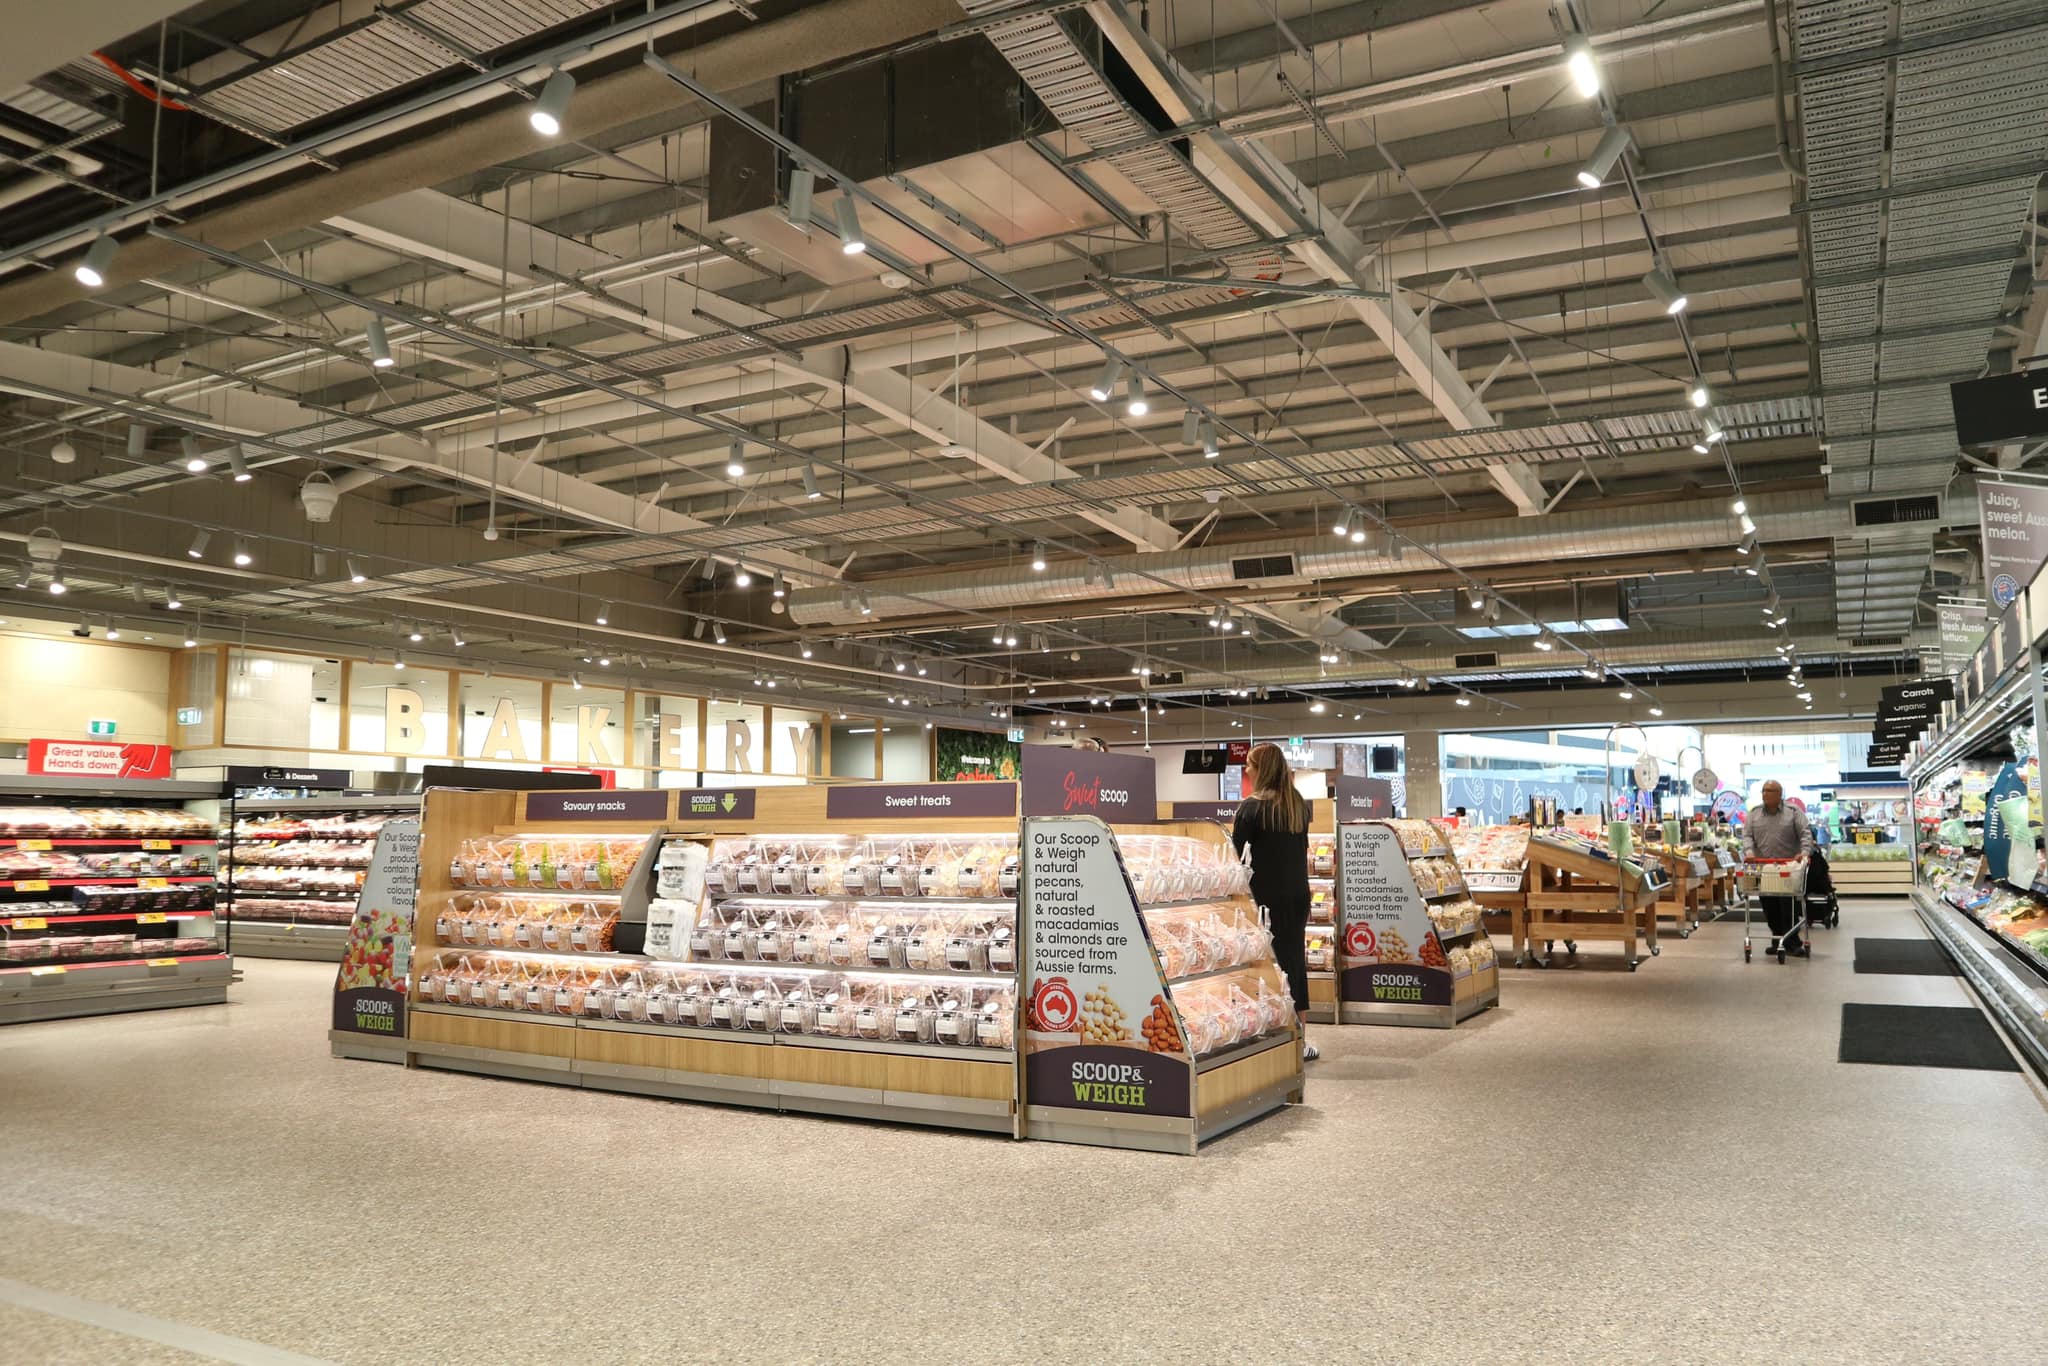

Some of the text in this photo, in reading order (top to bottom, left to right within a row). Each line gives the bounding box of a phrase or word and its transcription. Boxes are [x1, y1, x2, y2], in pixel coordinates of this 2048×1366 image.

[1987, 511, 2023, 524] sweet
[1988, 526, 2030, 541] melon.
[1901, 687, 1935, 698] Carrots
[385, 687, 814, 777] BAKERY
[51, 746, 119, 759] Great value.
[48, 759, 120, 770] Hands down.
[1062, 770, 1128, 811] Sweet scoop
[563, 800, 626, 812] Savoury snacks
[885, 795, 951, 807] Sweet treats
[691, 804, 717, 813] WEIGH
[1034, 833, 1100, 848] Our Scoop
[1345, 832, 1390, 841] Our Scoop
[400, 843, 417, 854] Weig
[1345, 841, 1380, 850] & Weigh
[390, 854, 417, 864] product
[1034, 848, 1086, 862] & Weigh
[1345, 850, 1375, 858] natural
[383, 864, 409, 873] contain
[1034, 862, 1078, 873] natural
[1345, 868, 1376, 876] natural
[1034, 876, 1084, 889] pecans,
[1354, 876, 1387, 885] roasted
[386, 885, 412, 894] colours
[1346, 885, 1404, 893] macadamias
[1034, 890, 1078, 901] natural
[1346, 894, 1409, 903] & almonds are
[1035, 904, 1095, 916] & roasted
[1346, 903, 1403, 911] sourced from
[1346, 912, 1374, 920] Aussie
[1035, 919, 1119, 931] macadamias
[1035, 933, 1128, 946] & almonds are
[1035, 947, 1118, 961] sourced from
[1035, 960, 1117, 975] Aussie farms.
[1372, 987, 1422, 1000] WEIGH
[356, 1013, 395, 1031] WEIGH
[1072, 1061, 1145, 1084] SCOOP&
[1072, 1081, 1146, 1107] WEIGH
